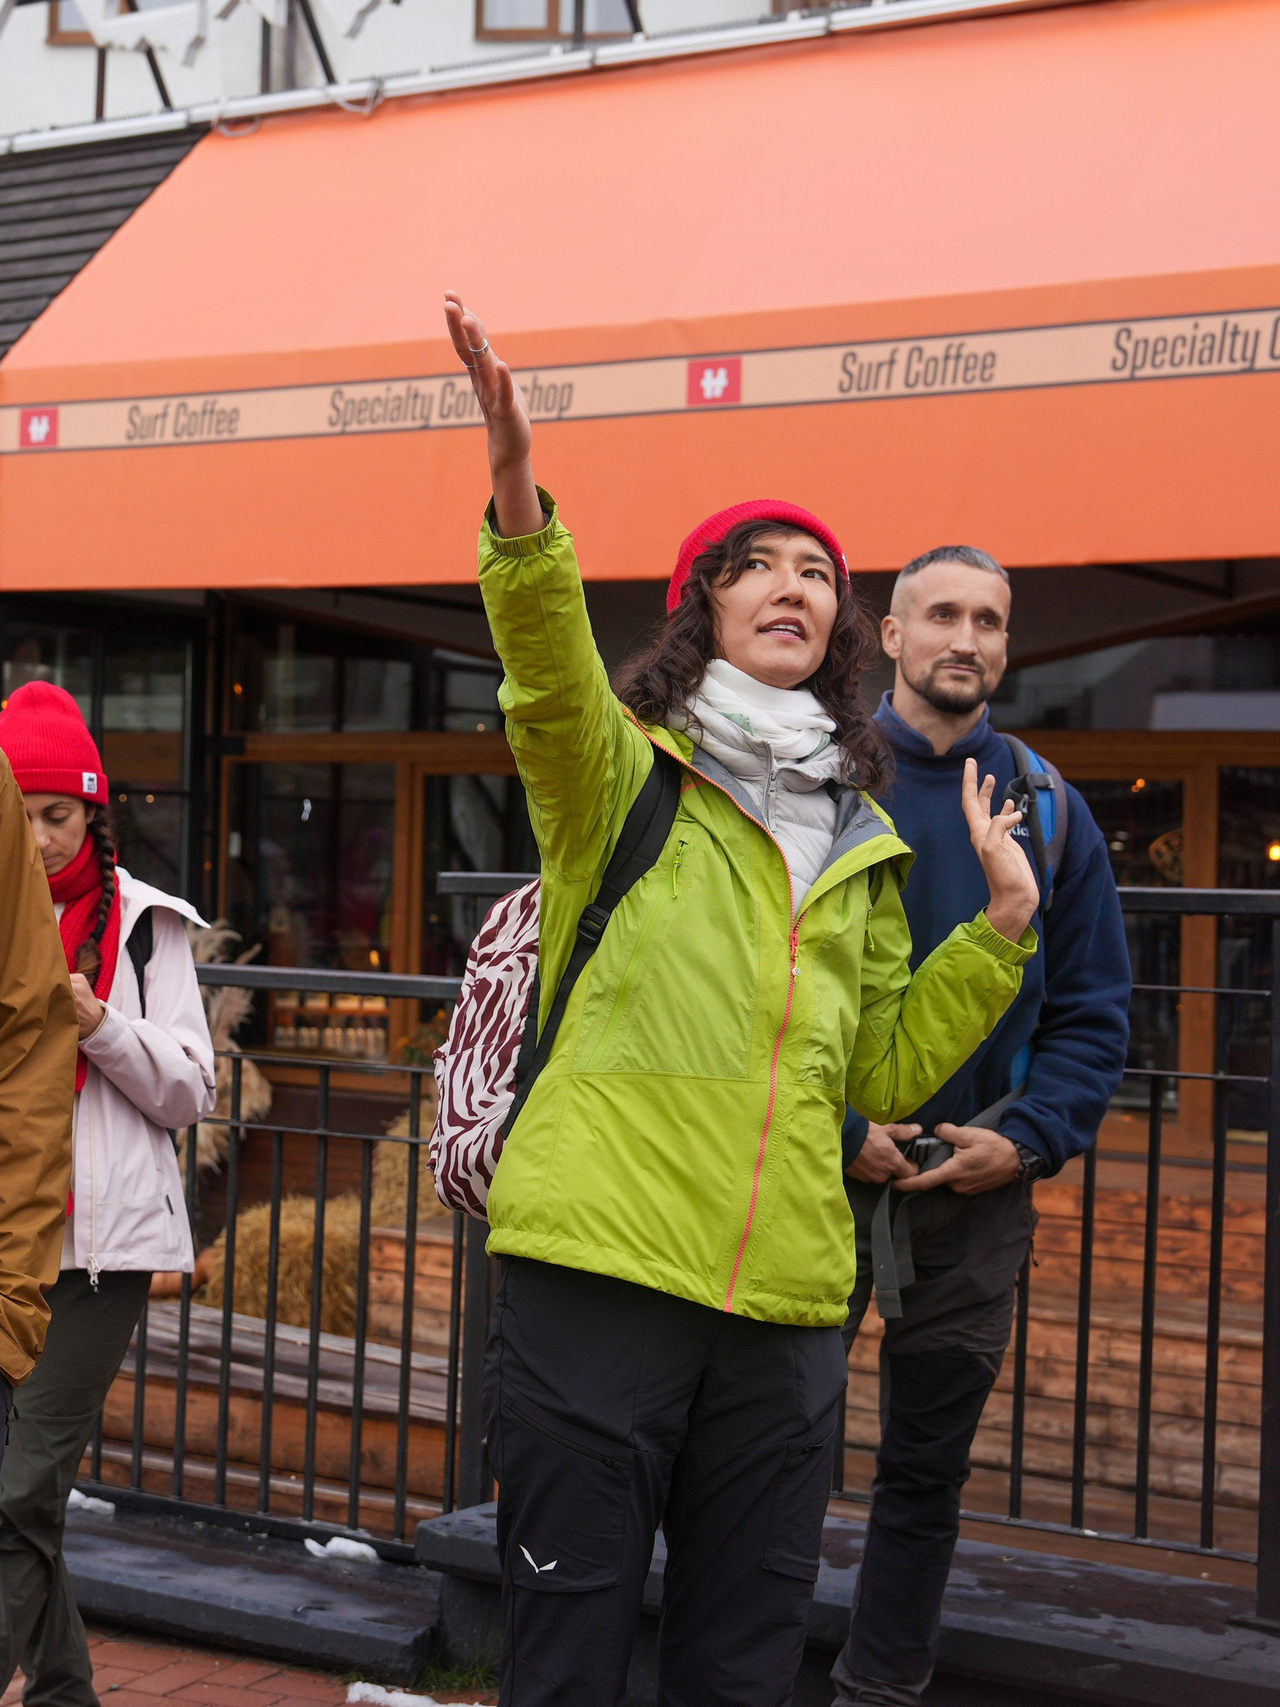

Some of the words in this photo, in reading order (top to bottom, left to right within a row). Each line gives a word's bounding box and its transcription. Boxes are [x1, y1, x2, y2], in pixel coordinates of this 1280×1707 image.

[838, 347, 898, 394] Surf
[903, 342, 997, 389] Coffee
[1111, 319, 1261, 379] Specialty
[125, 402, 170, 440] Surf
[173, 400, 241, 438] Coffee
[328, 384, 435, 434] Specialty
